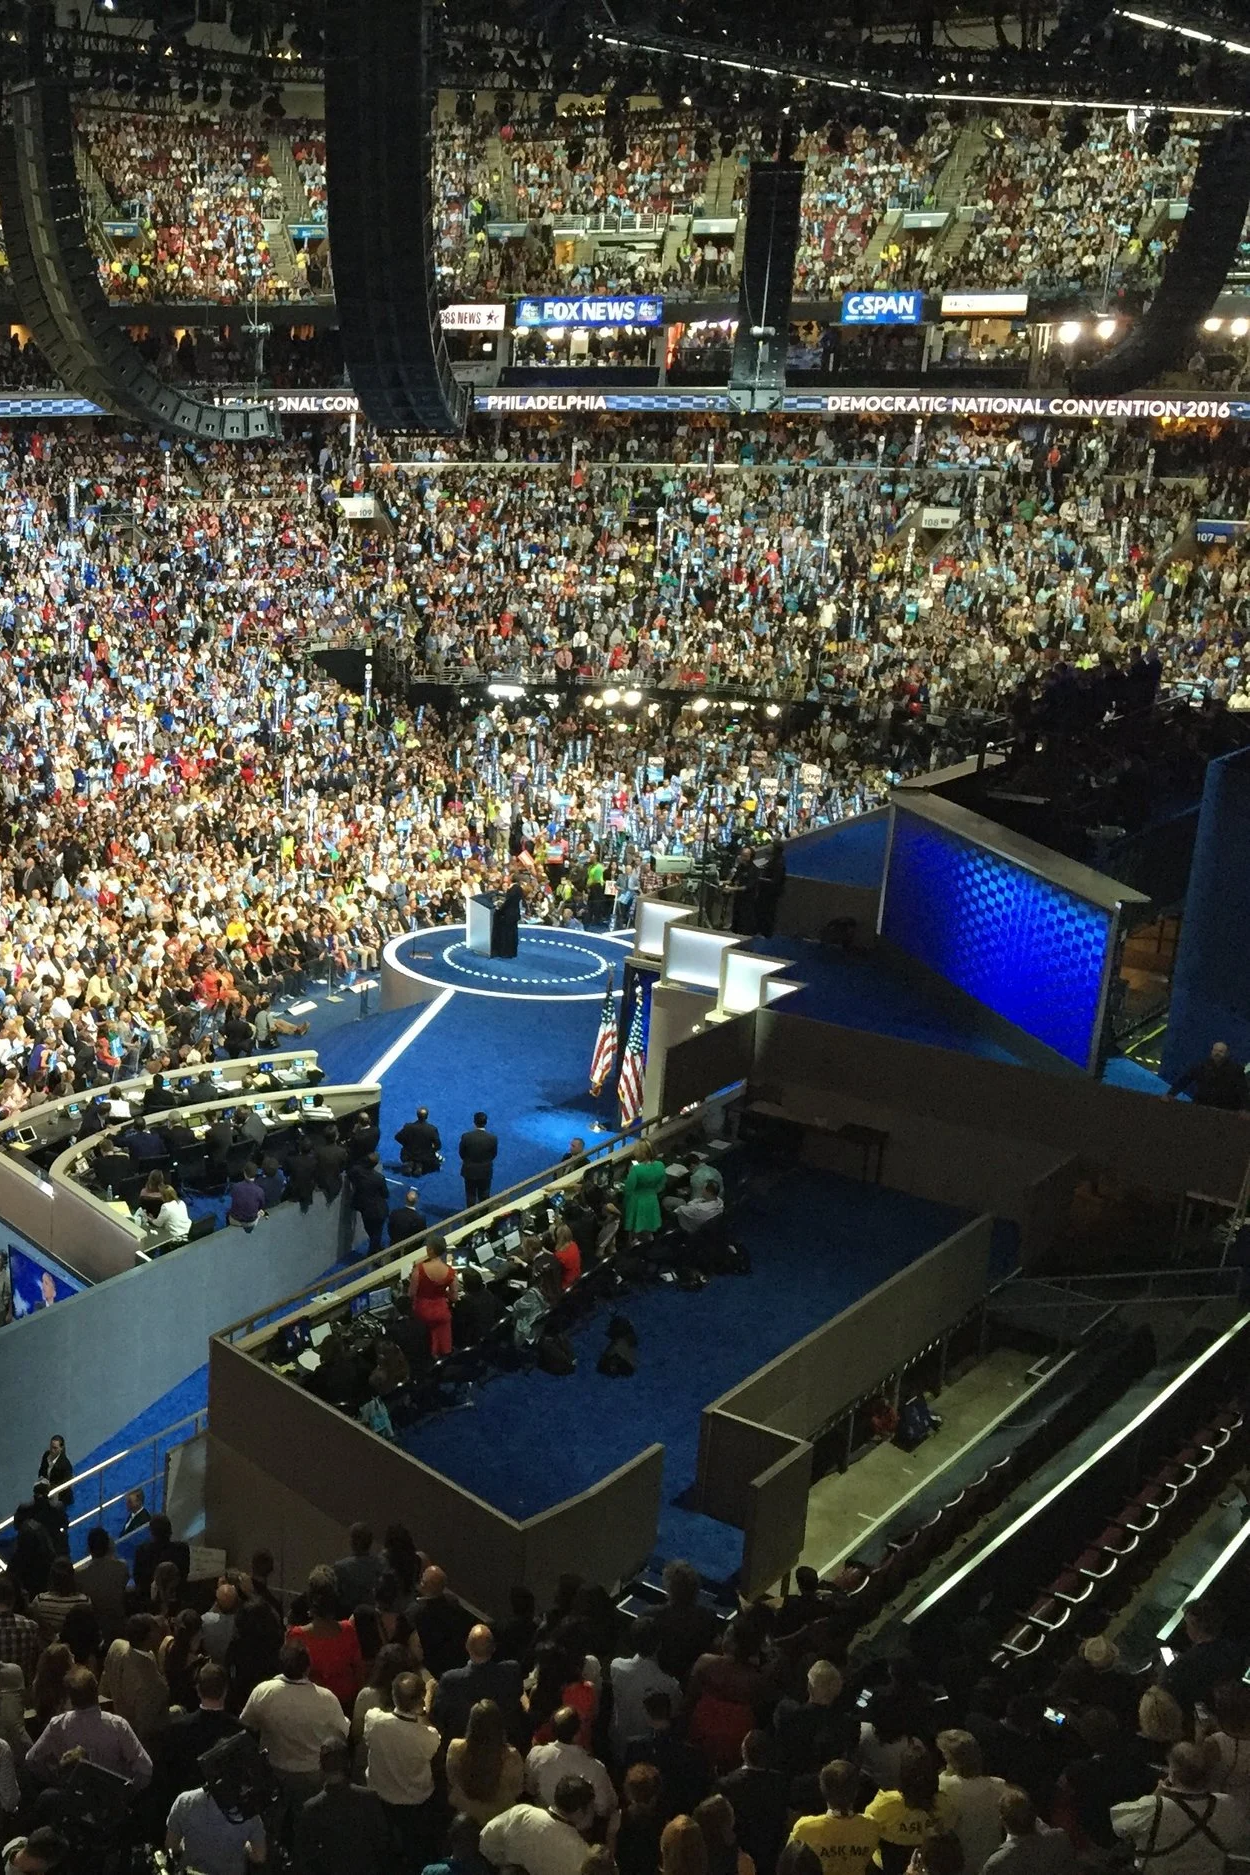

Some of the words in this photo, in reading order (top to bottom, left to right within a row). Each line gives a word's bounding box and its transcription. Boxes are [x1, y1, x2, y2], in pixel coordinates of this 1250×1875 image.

[543, 302, 581, 320] FOX
[582, 302, 635, 320] NEWS
[847, 296, 915, 315] C-SPAN
[457, 311, 481, 325] NEWS
[487, 395, 607, 411] PHILADELPHIA
[828, 394, 947, 413] DEMOCRATIC
[950, 397, 1046, 415] NATIONAL
[1050, 399, 1182, 417] CONVENTION
[1184, 402, 1231, 418] 2016
[924, 518, 939, 527] 108
[1197, 533, 1215, 542] 107
[820, 1845, 846, 1859] ASK
